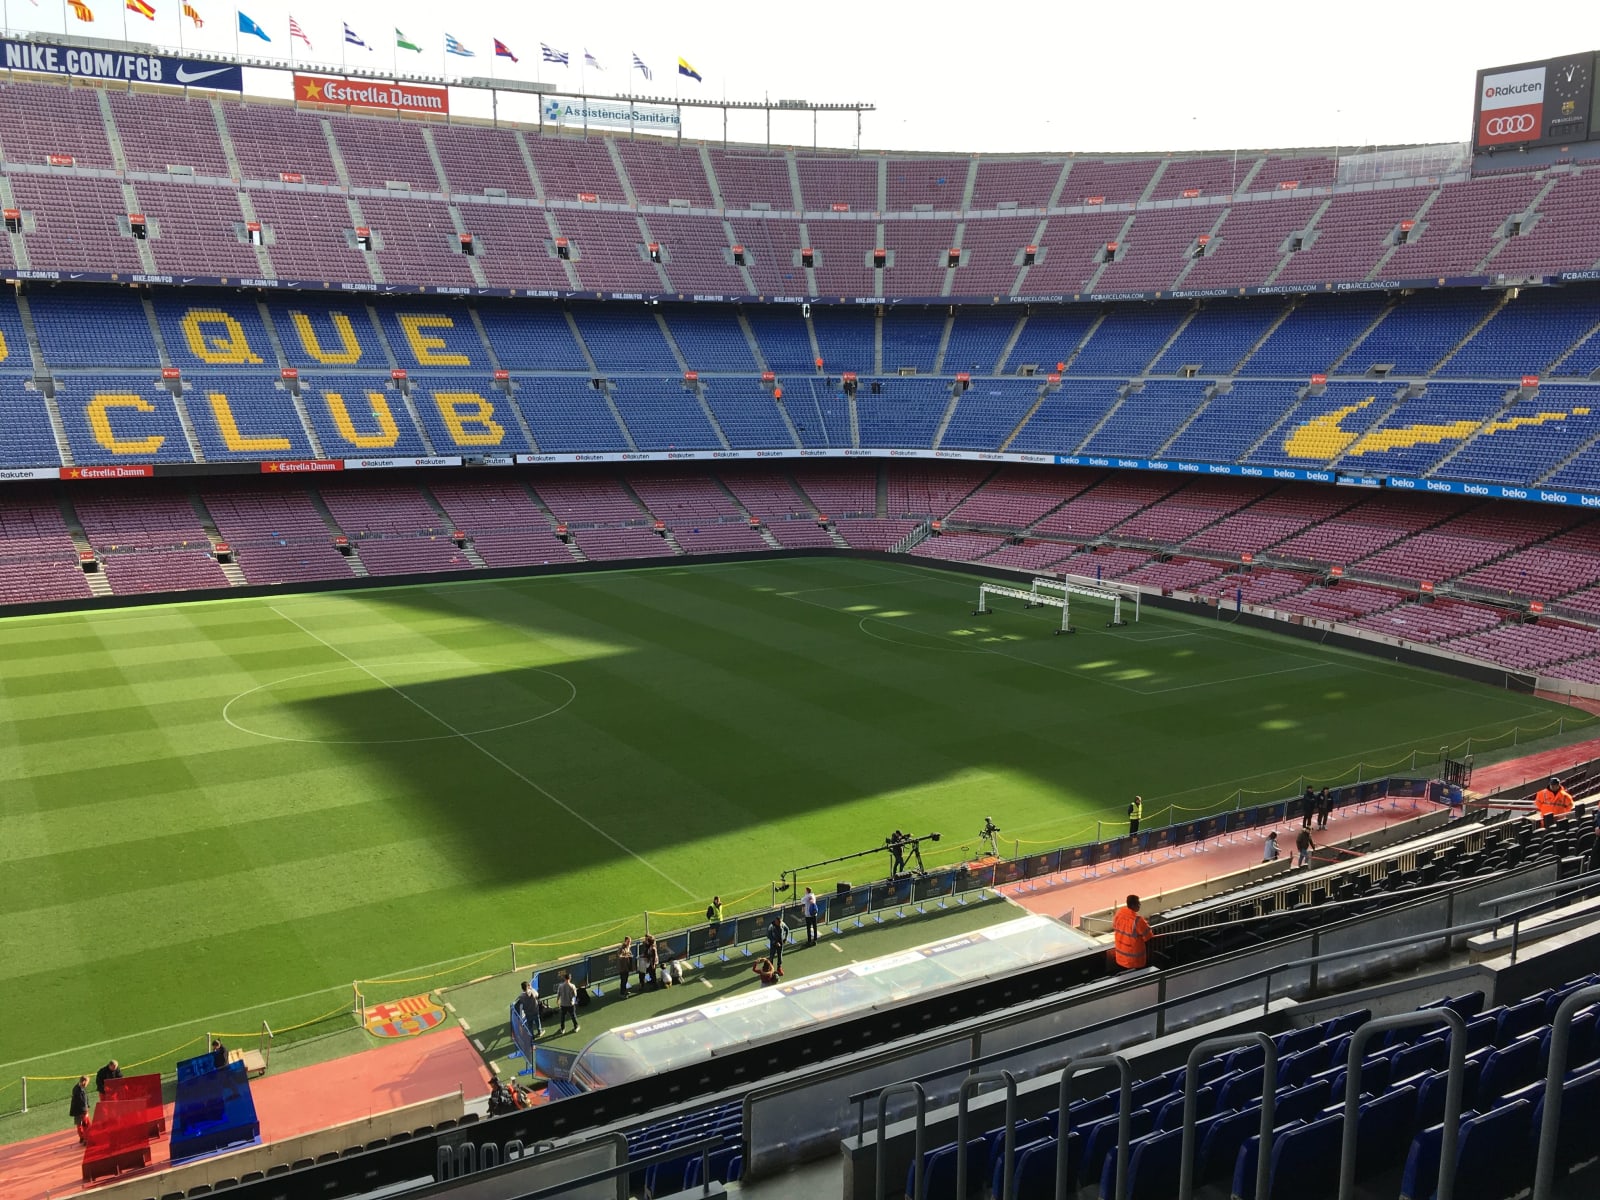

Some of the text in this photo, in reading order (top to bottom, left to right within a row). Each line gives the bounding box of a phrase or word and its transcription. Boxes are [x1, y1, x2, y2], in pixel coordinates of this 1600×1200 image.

[5, 43, 162, 81] NIKE.COM/FCB
[323, 81, 442, 108] Estrella Damm
[1494, 82, 1542, 97] Rakuten
[564, 105, 631, 121] Assistència
[16, 270, 59, 279] NIKE.COM/FCB
[132, 275, 173, 283] NIKE.COM/FCB
[240, 279, 279, 287] NIKE.COM/FCB
[86, 393, 505, 454] CLUB
[367, 459, 394, 467] Rakuten
[1060, 456, 1080, 465] beko
[1089, 457, 1109, 466] beko
[1118, 459, 1138, 468] beko
[1148, 460, 1169, 469] beko
[279, 461, 336, 471] Estrella Damm
[1178, 462, 1199, 471] beko
[1209, 464, 1230, 474] beko
[0, 471, 34, 479] Rakuten
[81, 467, 145, 477] Estrella Damm
[1241, 467, 1262, 476] beko
[1273, 469, 1295, 478] beko
[1306, 471, 1329, 481] beko
[1391, 478, 1415, 488] beko
[1427, 481, 1451, 491] beko
[1464, 484, 1488, 495] beko
[1502, 488, 1527, 499] beko
[1541, 491, 1567, 503] beko
